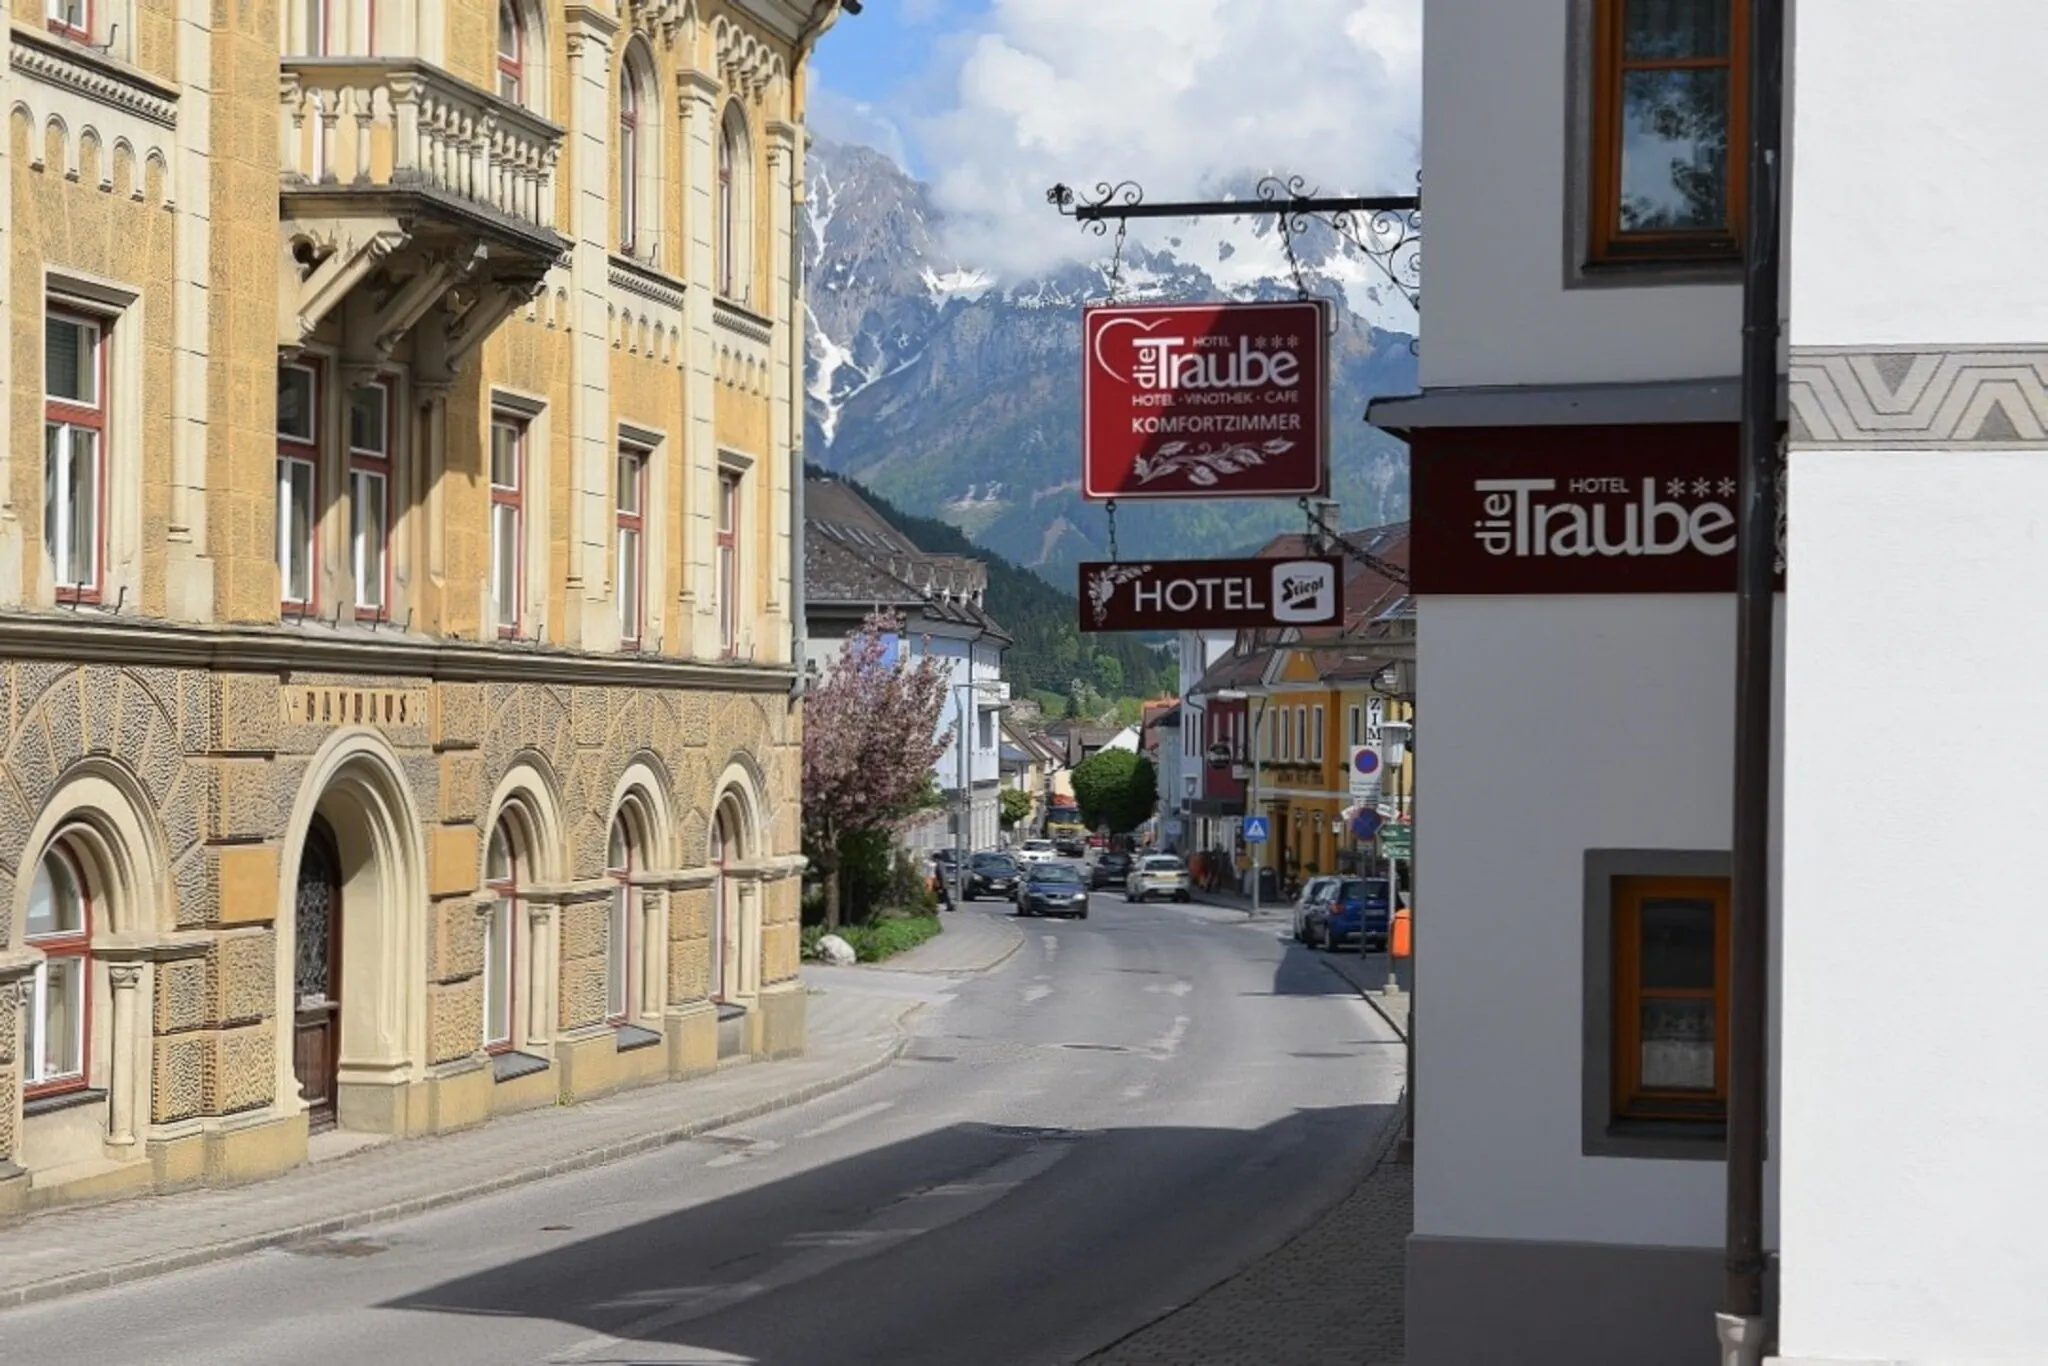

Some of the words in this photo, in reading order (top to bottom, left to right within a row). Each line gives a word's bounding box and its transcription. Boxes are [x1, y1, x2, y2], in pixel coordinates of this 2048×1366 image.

[1193, 335, 1230, 347] HOTEL
[1132, 335, 1300, 389] Traube
[1132, 348, 1156, 389] die
[1132, 393, 1176, 406] HOTEL
[1184, 390, 1253, 405] VINOTHEK
[1132, 414, 1301, 433] KOMFORTZIMMER
[1569, 478, 1630, 494] HOTEL
[1475, 477, 1737, 557] Traube
[1475, 493, 1511, 555] die
[1135, 577, 1265, 612] HOTEL
